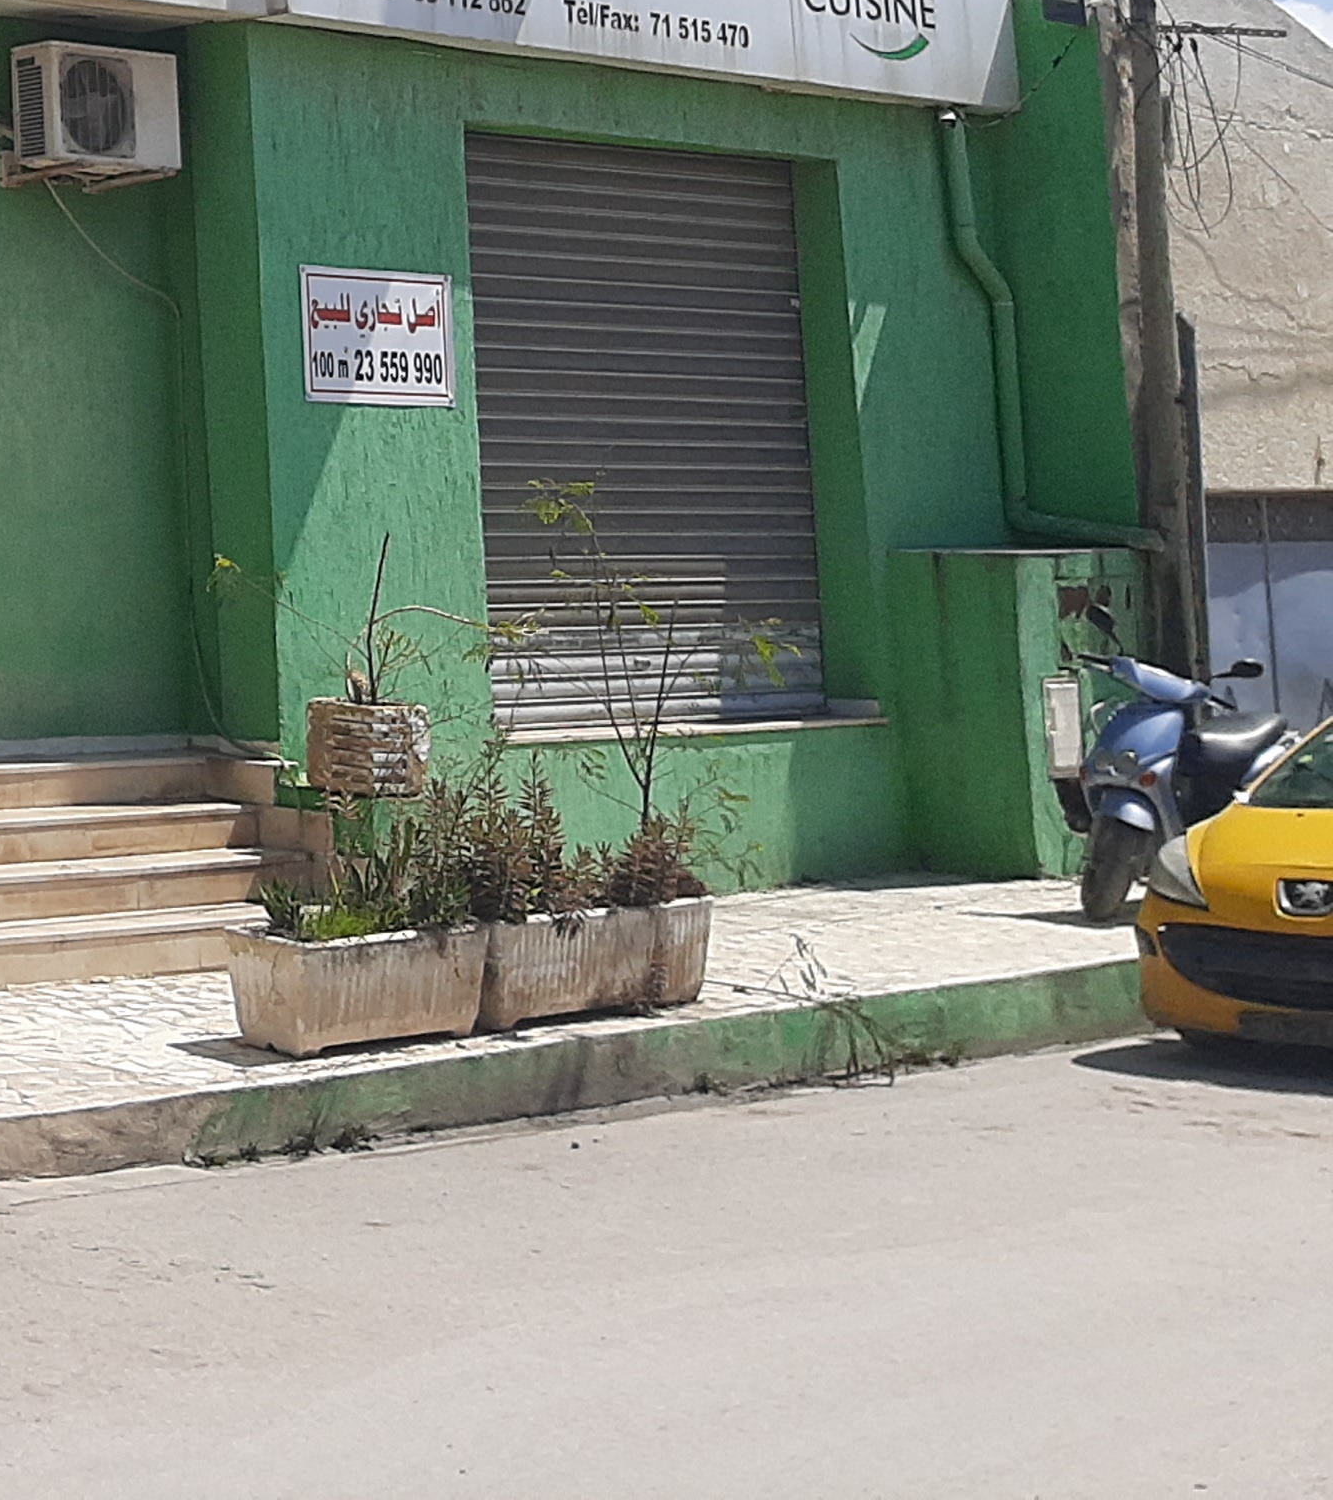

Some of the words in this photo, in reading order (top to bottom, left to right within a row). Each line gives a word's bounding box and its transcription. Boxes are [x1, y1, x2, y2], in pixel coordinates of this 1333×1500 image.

[649, 12, 672, 40] 71
[678, 17, 712, 44] 515
[716, 22, 750, 48] 470
[310, 293, 351, 329] للبيع
[355, 295, 402, 338] تجاري
[312, 350, 334, 378] 100
[355, 350, 374, 382] 23
[380, 351, 409, 383] 559
[414, 353, 443, 385] 990
